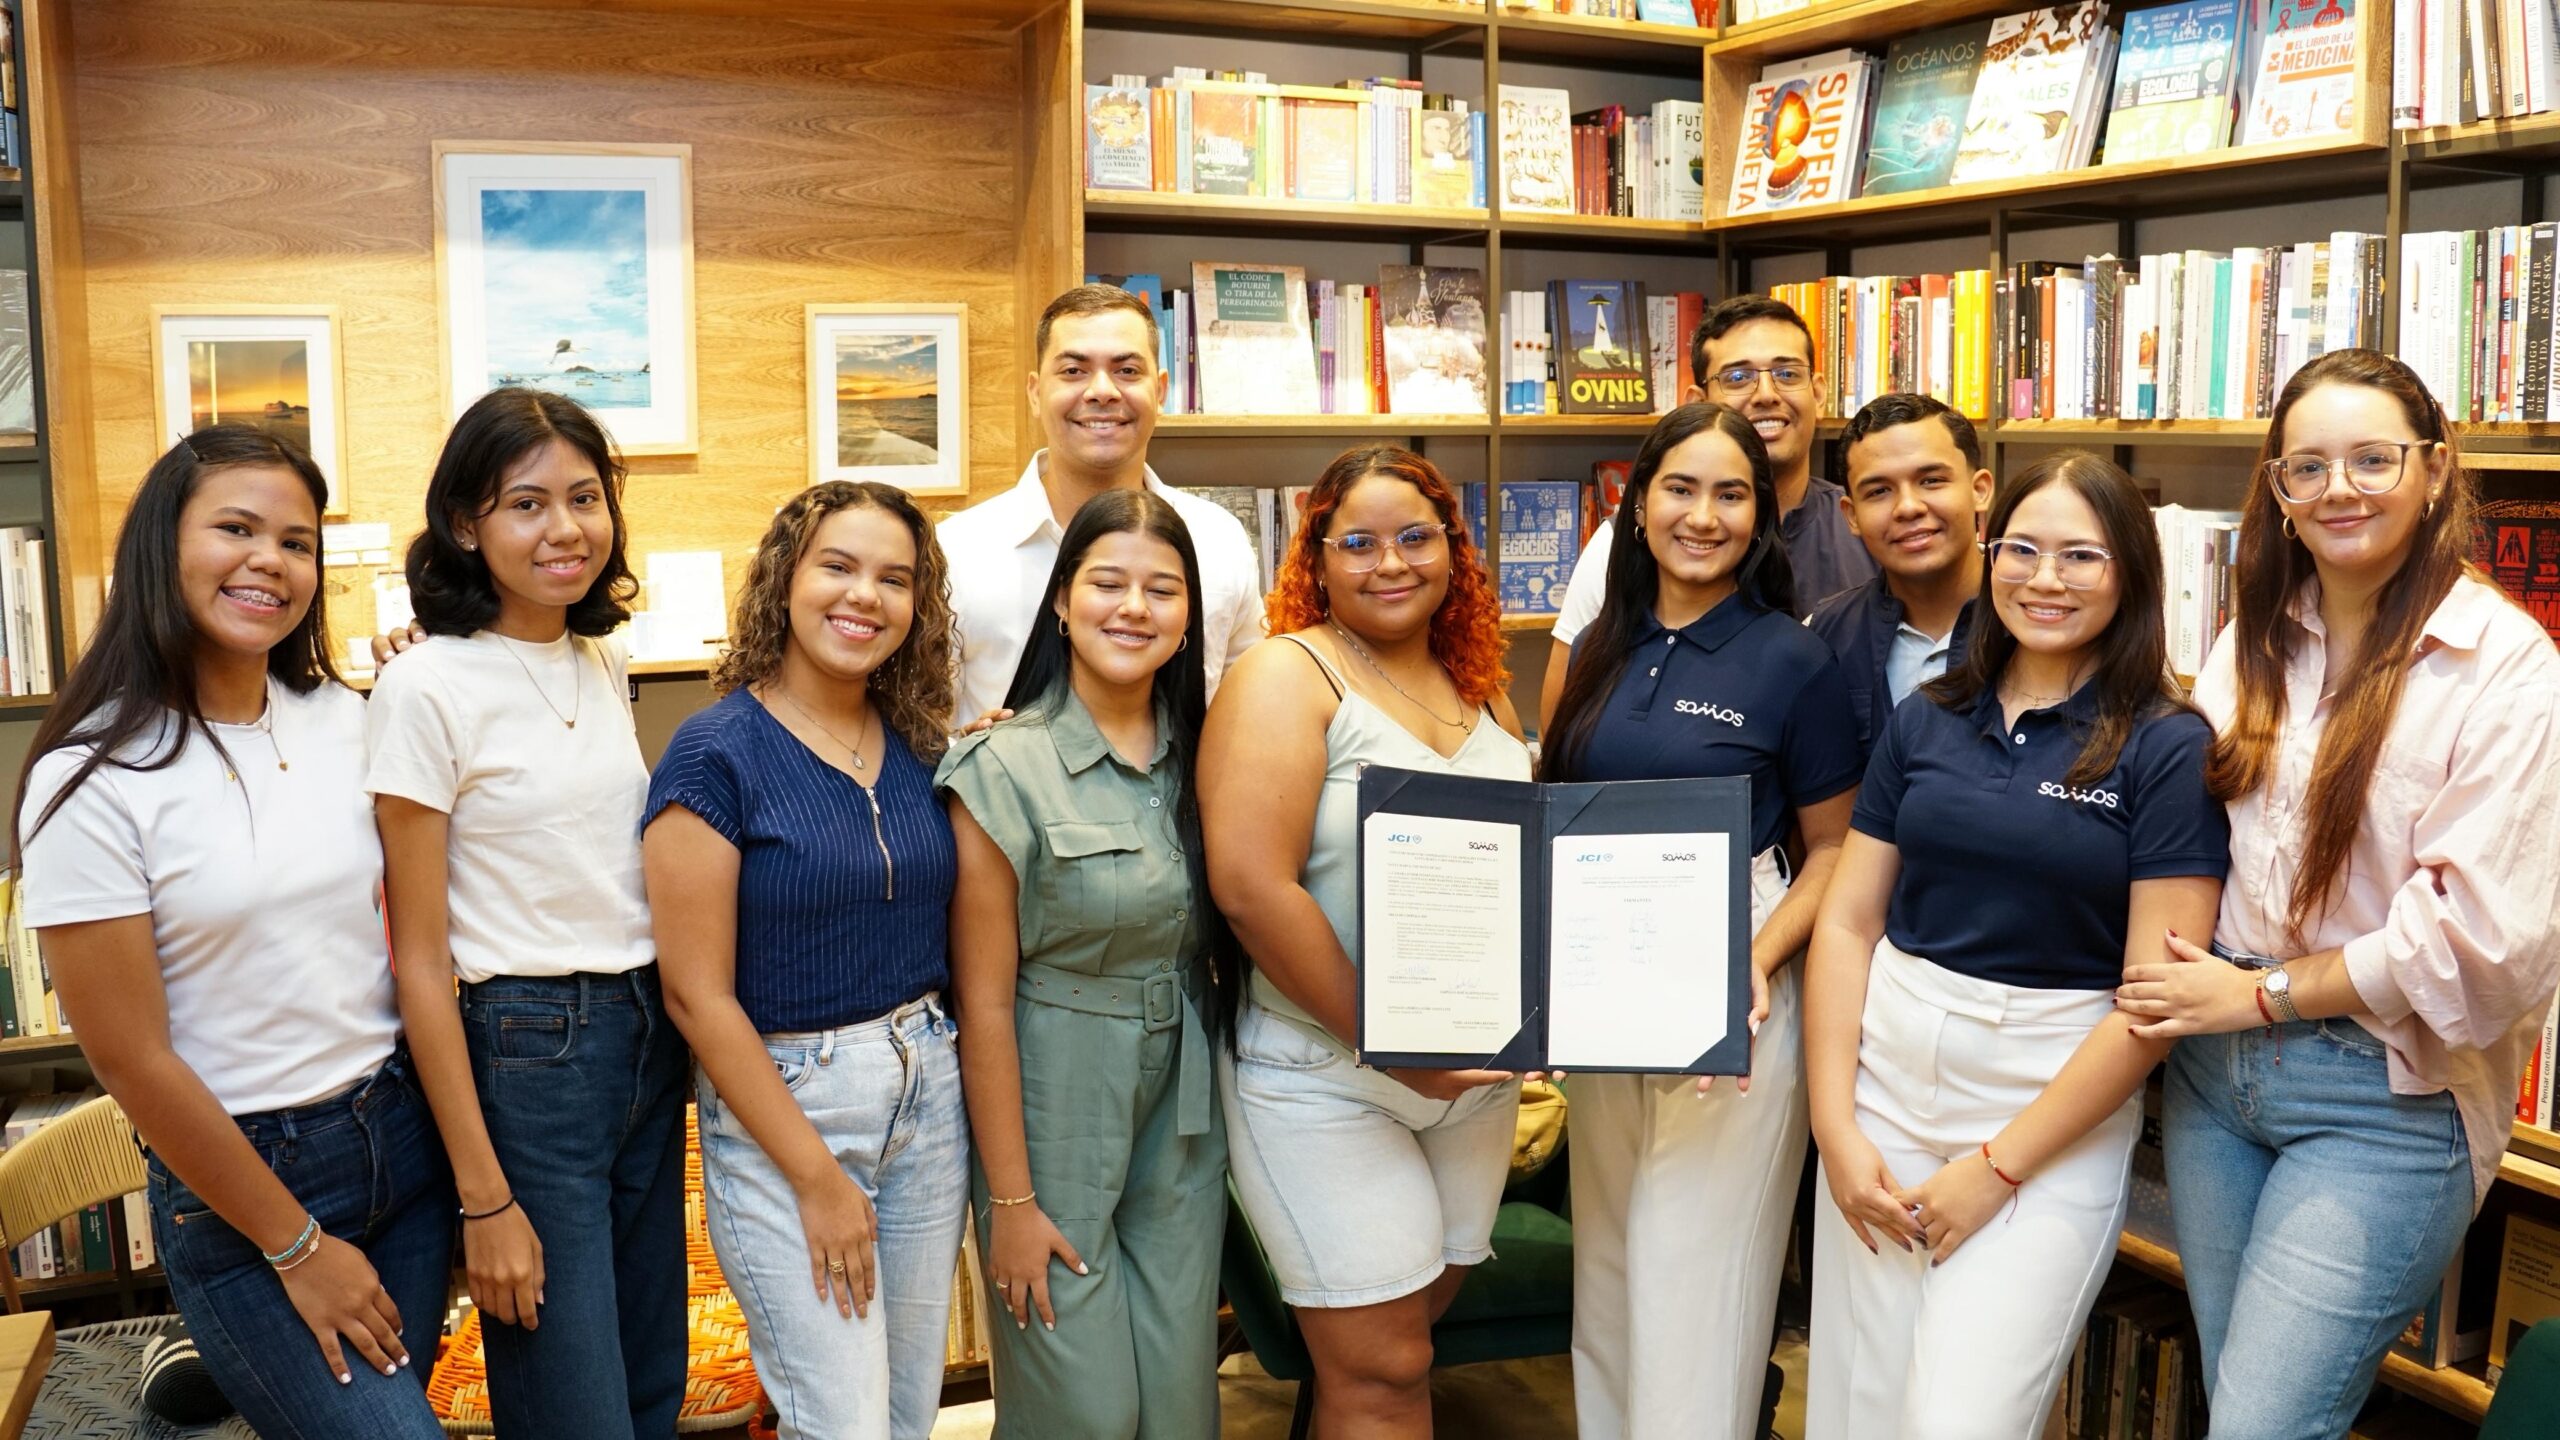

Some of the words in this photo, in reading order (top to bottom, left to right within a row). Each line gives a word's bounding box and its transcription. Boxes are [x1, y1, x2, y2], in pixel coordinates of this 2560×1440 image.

[1896, 41, 1976, 73] OCÉANOS
[1736, 86, 1775, 210] PLANETA
[1799, 71, 1848, 201] SUPER
[1228, 273, 1240, 281] EL
[1241, 273, 1271, 282] CÓDICE
[1231, 281, 1271, 290] BOTURINI
[2531, 261, 2541, 315] WALTER
[2541, 252, 2552, 320] ISAACSON
[1219, 297, 1285, 307] PEREGRINACIÓN
[1225, 289, 1232, 297] O
[1235, 289, 1253, 298] TIRA
[1254, 290, 1266, 298] DE
[1267, 291, 1278, 299] LA
[2503, 299, 2512, 312] ALTA
[1374, 308, 1382, 342] ESTOICOS
[1665, 314, 1677, 354] Nexus
[1374, 342, 1382, 355] LOS
[2087, 327, 2095, 359] CIENCIA
[2539, 337, 2549, 370] VIDA
[1374, 355, 1383, 365] DE
[2042, 340, 2050, 378] VIRGILIO
[2432, 359, 2440, 385] Adam
[2527, 339, 2538, 391] CÓDIGO
[1375, 366, 1383, 388] VIDAS
[2538, 375, 2547, 391] LA
[1571, 378, 1648, 404] OVNIS
[2086, 375, 2094, 408] PILARES
[2527, 395, 2535, 411] EL
[2537, 396, 2545, 413] DE
[2526, 591, 2550, 600] LIBRO
[1388, 834, 1411, 843] JCI
[1577, 854, 1601, 862] JCI
[2541, 1074, 2549, 1104] Pensar
[2545, 1026, 2553, 1059] claridad
